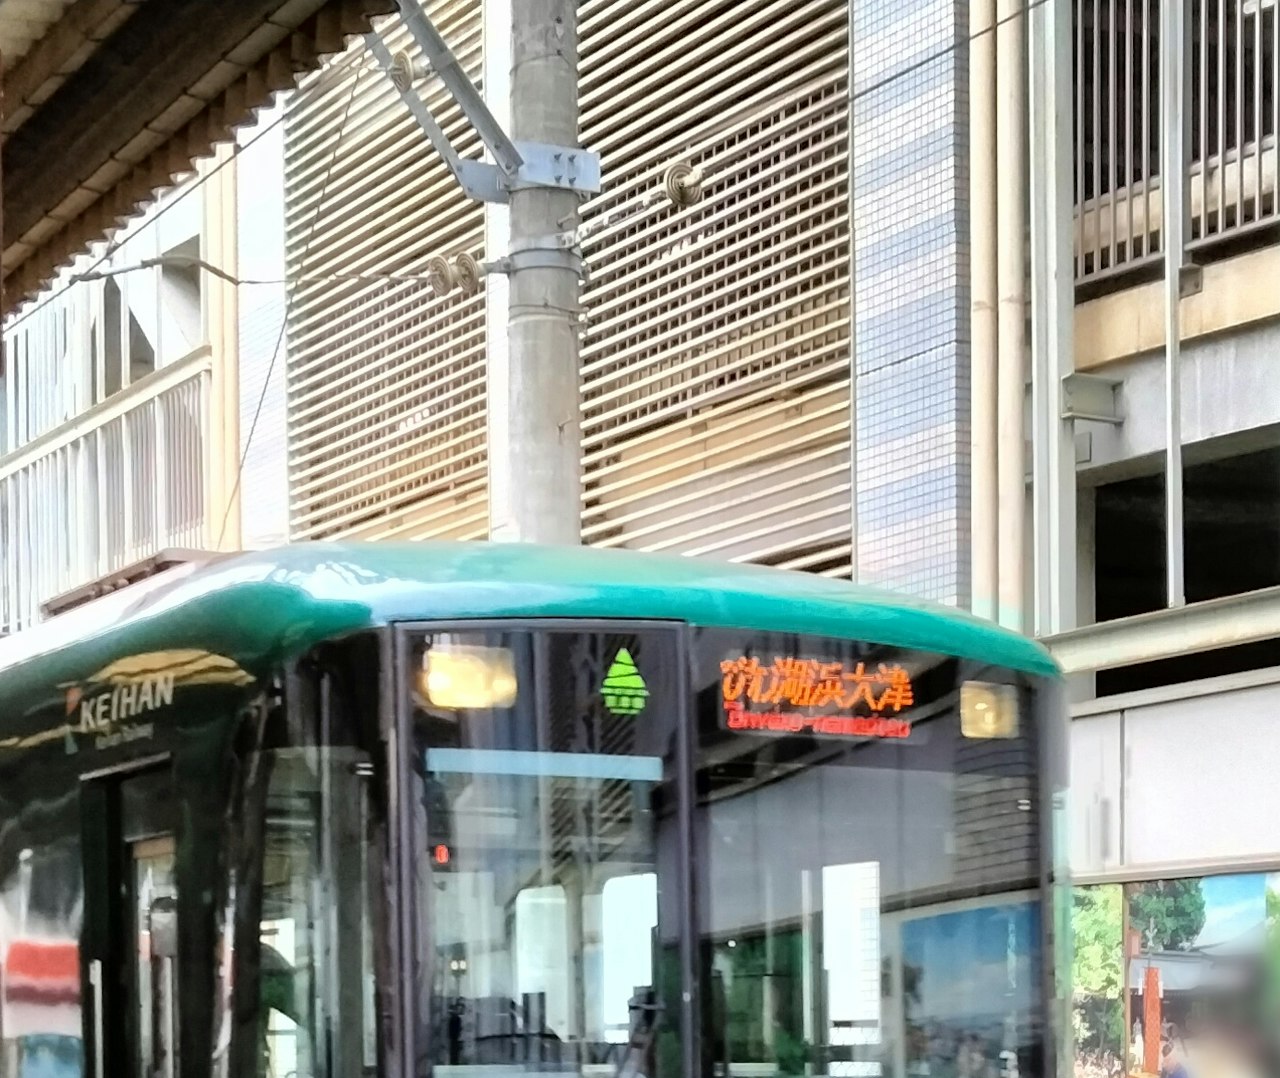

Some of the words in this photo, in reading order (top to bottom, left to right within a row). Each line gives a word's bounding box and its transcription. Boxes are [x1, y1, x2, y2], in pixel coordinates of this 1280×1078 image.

[81, 673, 175, 732] KEIHAN
[720, 656, 914, 711] びわ湖浜大津
